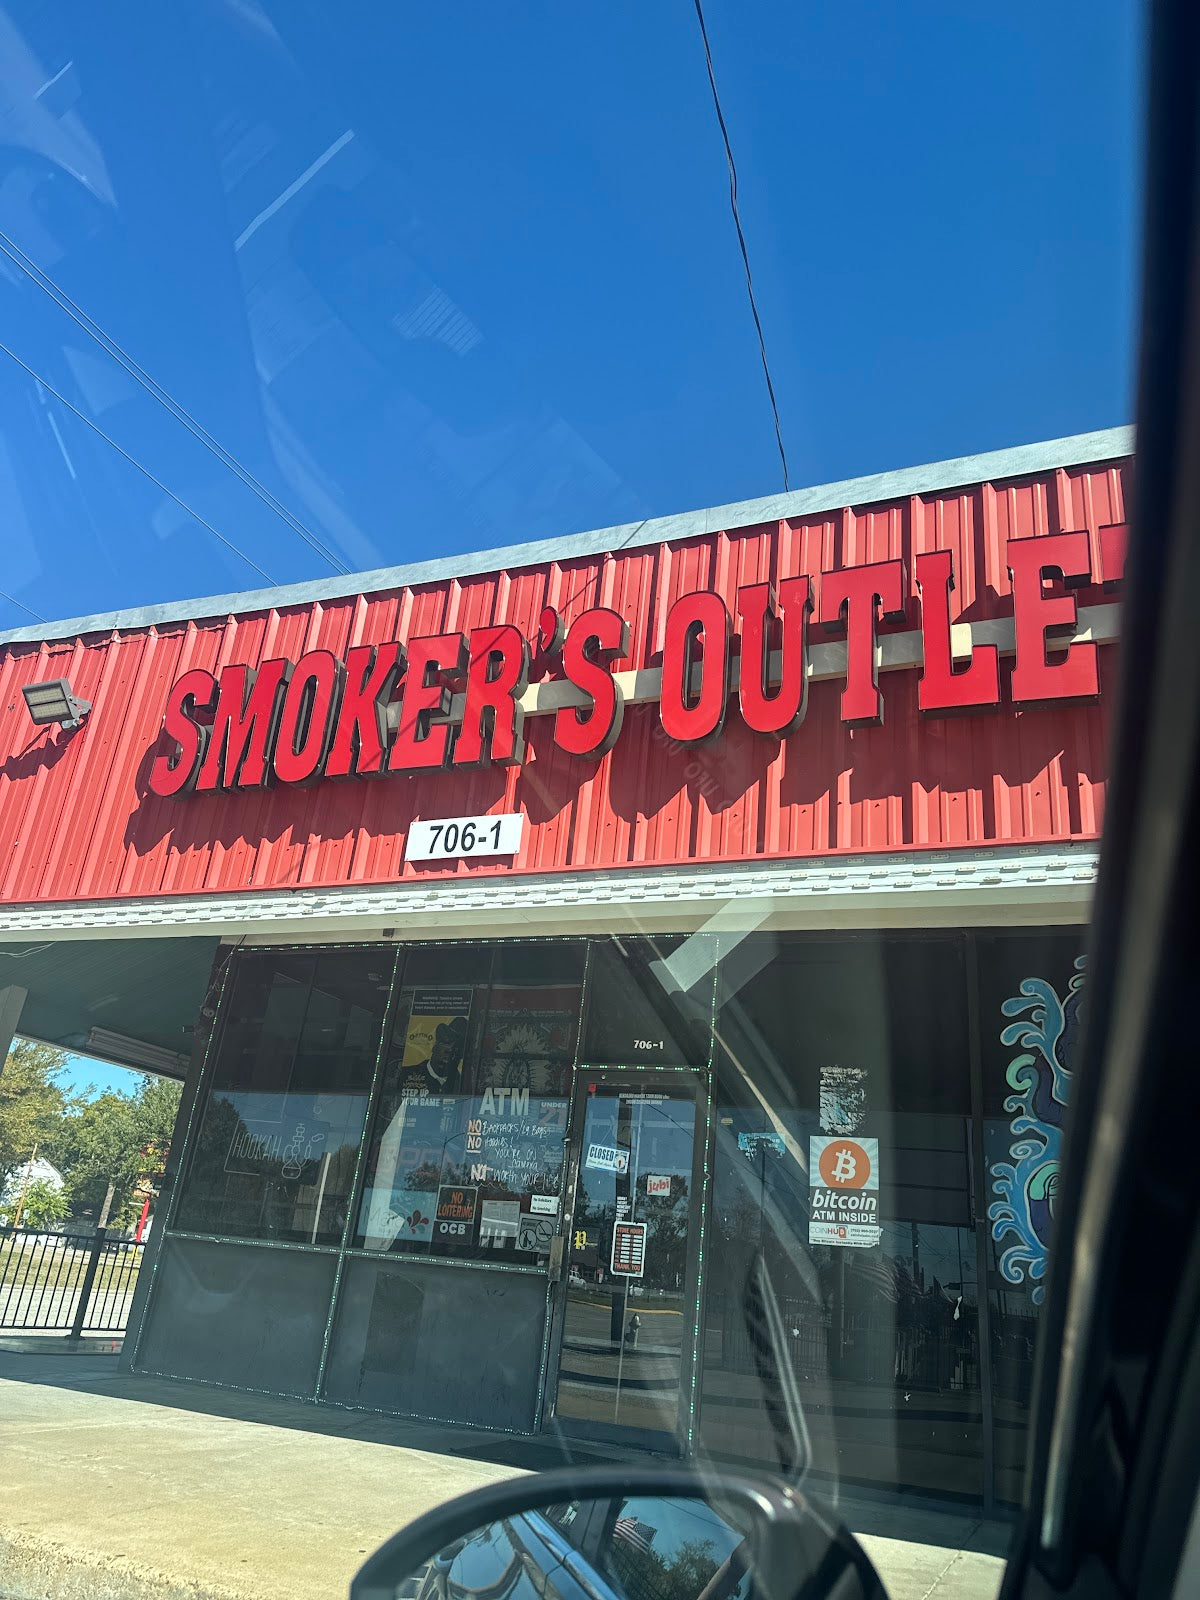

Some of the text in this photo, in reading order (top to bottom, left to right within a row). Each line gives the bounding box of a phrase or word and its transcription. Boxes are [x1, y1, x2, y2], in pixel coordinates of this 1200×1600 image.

[149, 605, 629, 799] SMOKER'S
[428, 819, 502, 855] 706-1
[633, 1039, 665, 1050] 706-1
[401, 1088, 430, 1098] STEP UP
[479, 1087, 530, 1116] ATM
[540, 1101, 568, 1109] UNDER
[537, 1108, 567, 1128] 21
[468, 1119, 481, 1133] NO
[231, 1132, 283, 1162] HOOKAH
[467, 1135, 482, 1150] NO
[589, 1146, 615, 1162] CLOSED
[471, 1163, 493, 1182] NOT
[451, 1191, 464, 1203] NO
[812, 1188, 877, 1211] bitcoin
[437, 1203, 474, 1220] LOITERING
[812, 1209, 877, 1223] ATM INSIDE
[439, 1223, 467, 1235] OCB
[617, 1226, 644, 1235] STORE HOURS
[614, 1262, 641, 1272] THANK YOU
